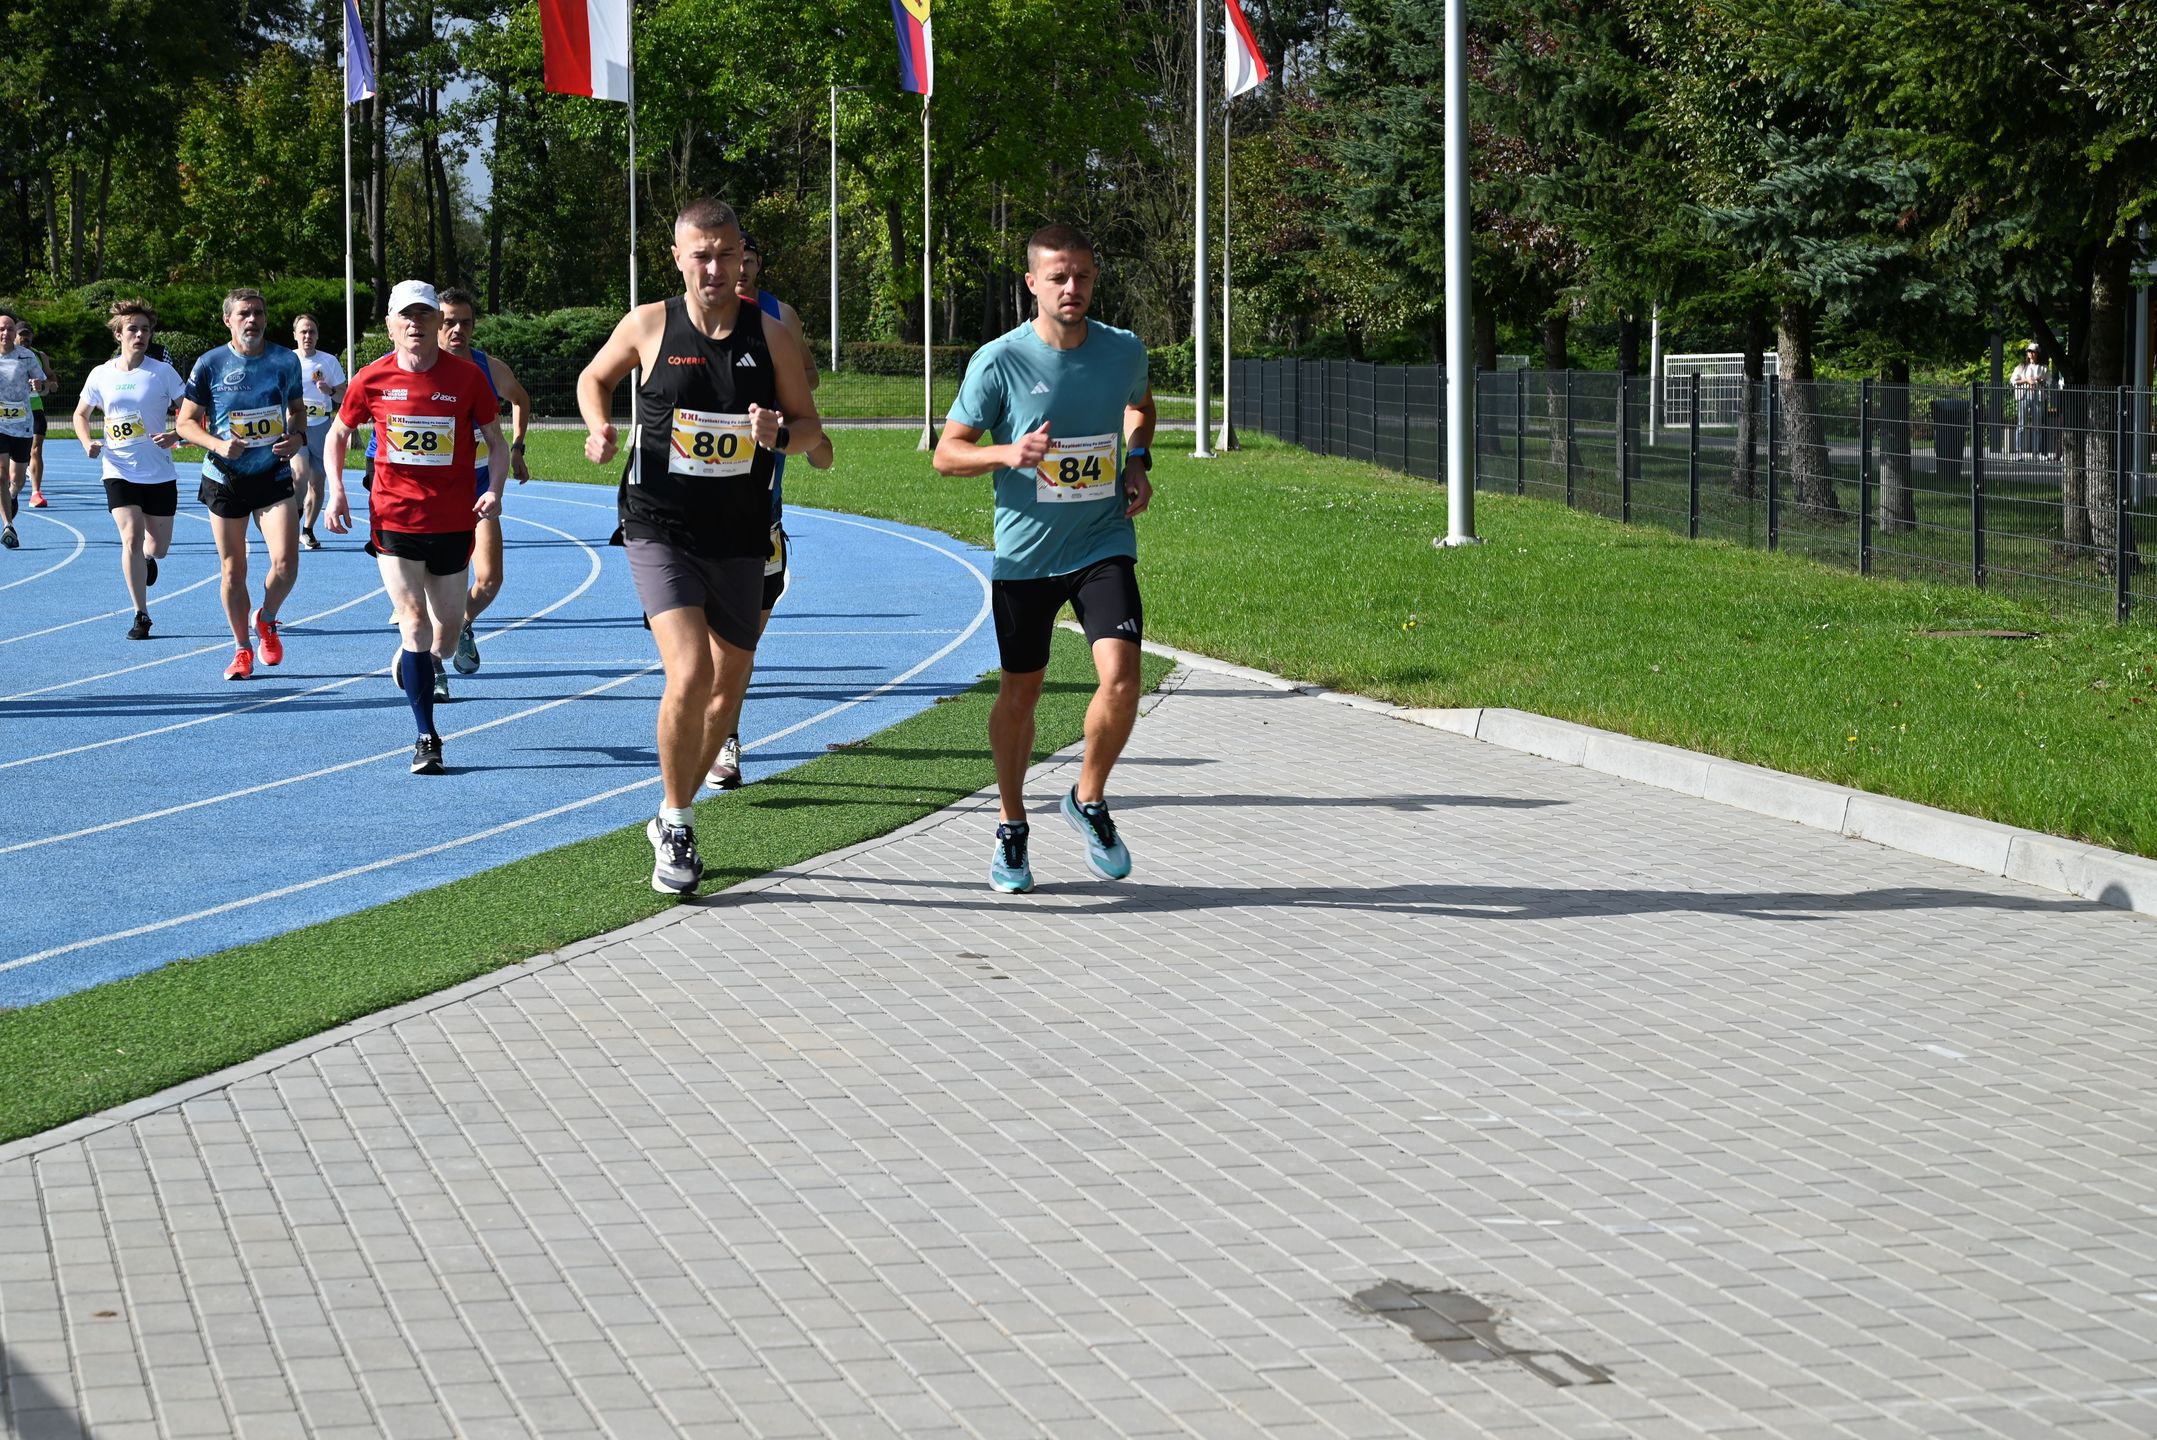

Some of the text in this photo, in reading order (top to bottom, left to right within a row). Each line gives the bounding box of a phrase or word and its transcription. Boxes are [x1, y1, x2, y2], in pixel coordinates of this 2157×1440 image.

[667, 356, 706, 365] COVERIS
[3, 408, 19, 417] 12
[680, 412, 698, 421] XXI
[112, 422, 133, 438] 88
[244, 419, 271, 437] 10
[403, 430, 438, 451] 28
[692, 431, 738, 459] 80
[1058, 455, 1102, 483] 84
